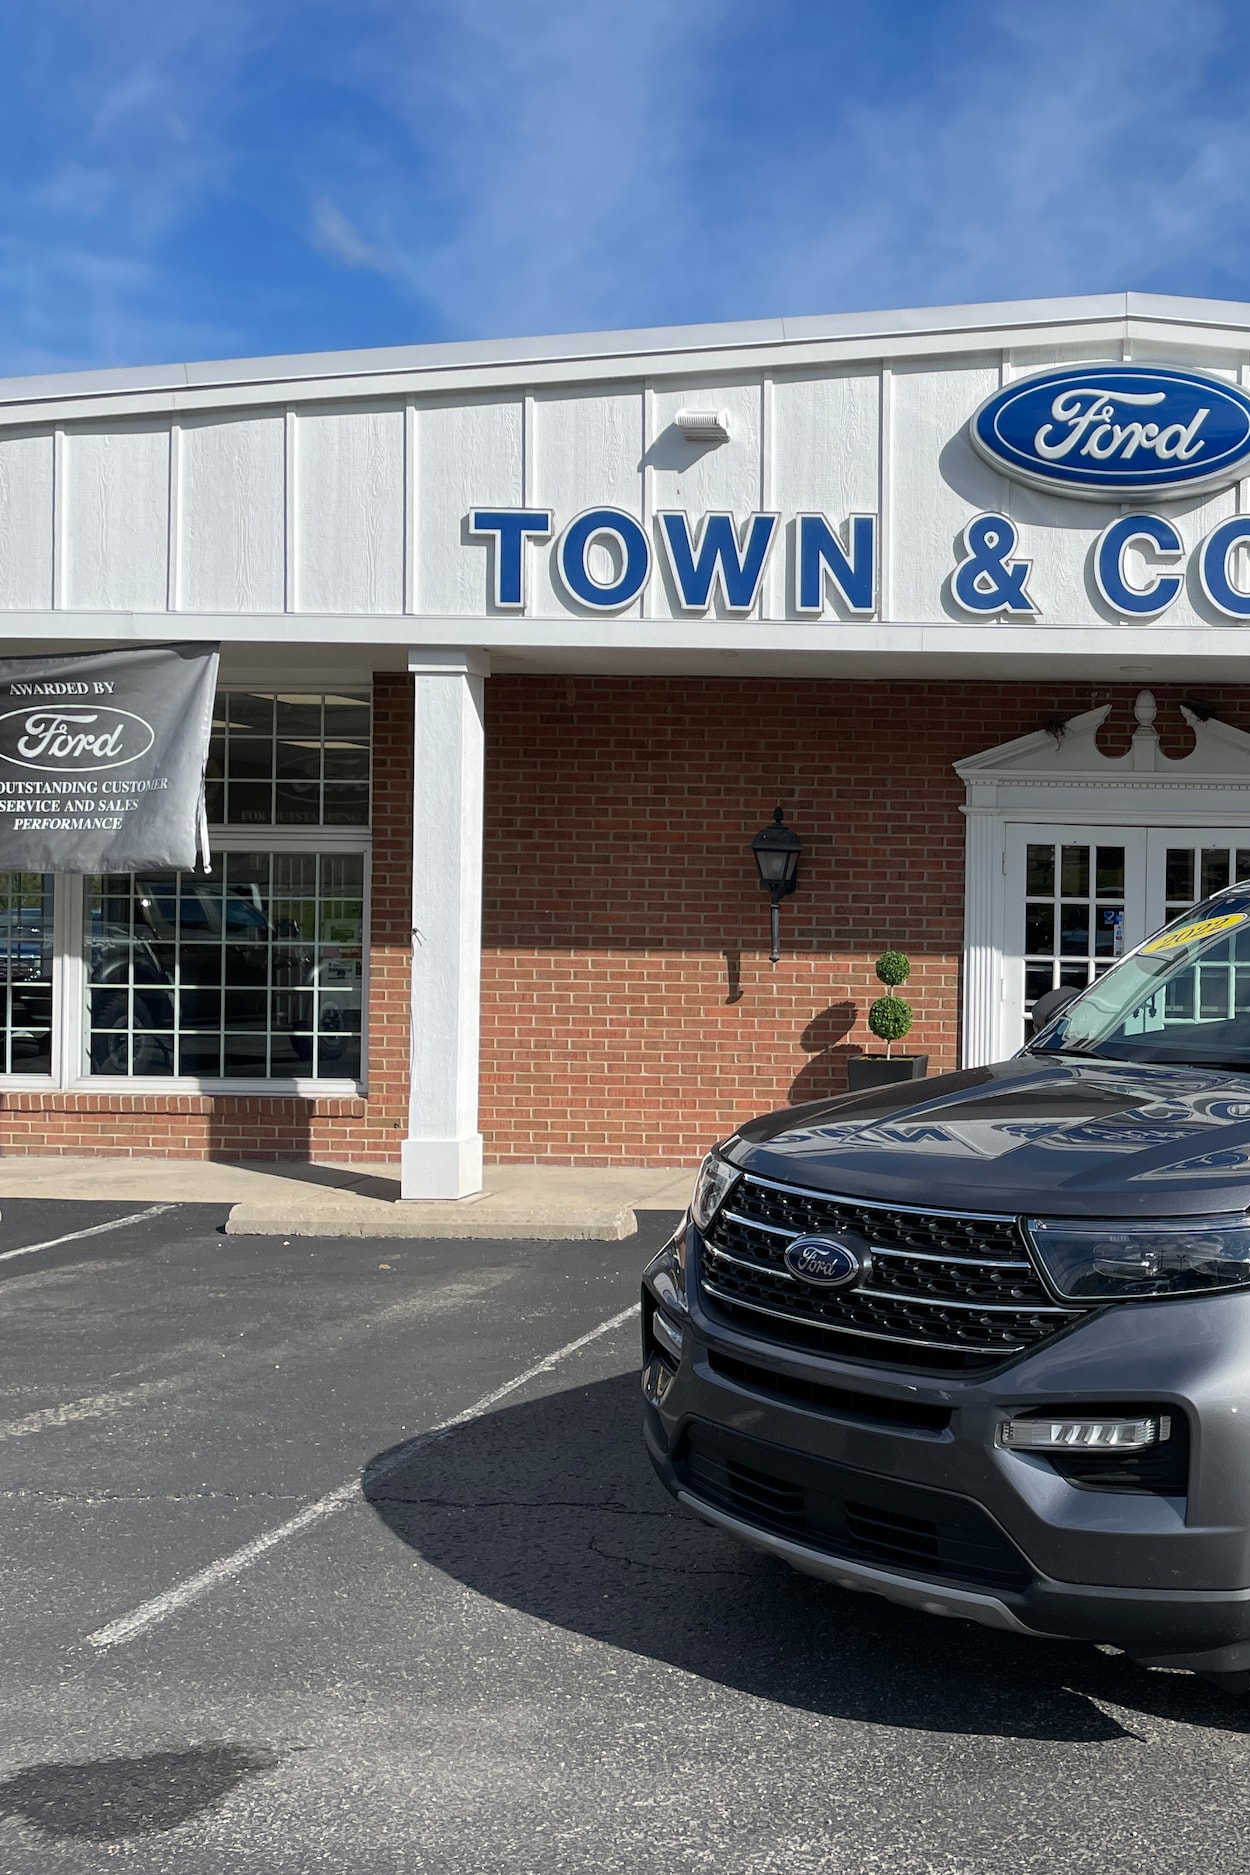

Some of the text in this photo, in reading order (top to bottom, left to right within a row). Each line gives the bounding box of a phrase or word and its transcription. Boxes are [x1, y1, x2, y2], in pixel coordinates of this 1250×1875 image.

[1034, 388, 1210, 460] Ford
[469, 508, 878, 614] TOWN
[950, 511, 1041, 615] &
[10, 681, 115, 696] AWARDED BY
[17, 713, 124, 758] Ford
[102, 777, 168, 793] CUSTOMER
[0, 799, 138, 812] SERVICE AND SALES
[13, 817, 122, 830] PERFORMANCE
[1155, 917, 1230, 950] 2022
[798, 1246, 838, 1276] Ford
